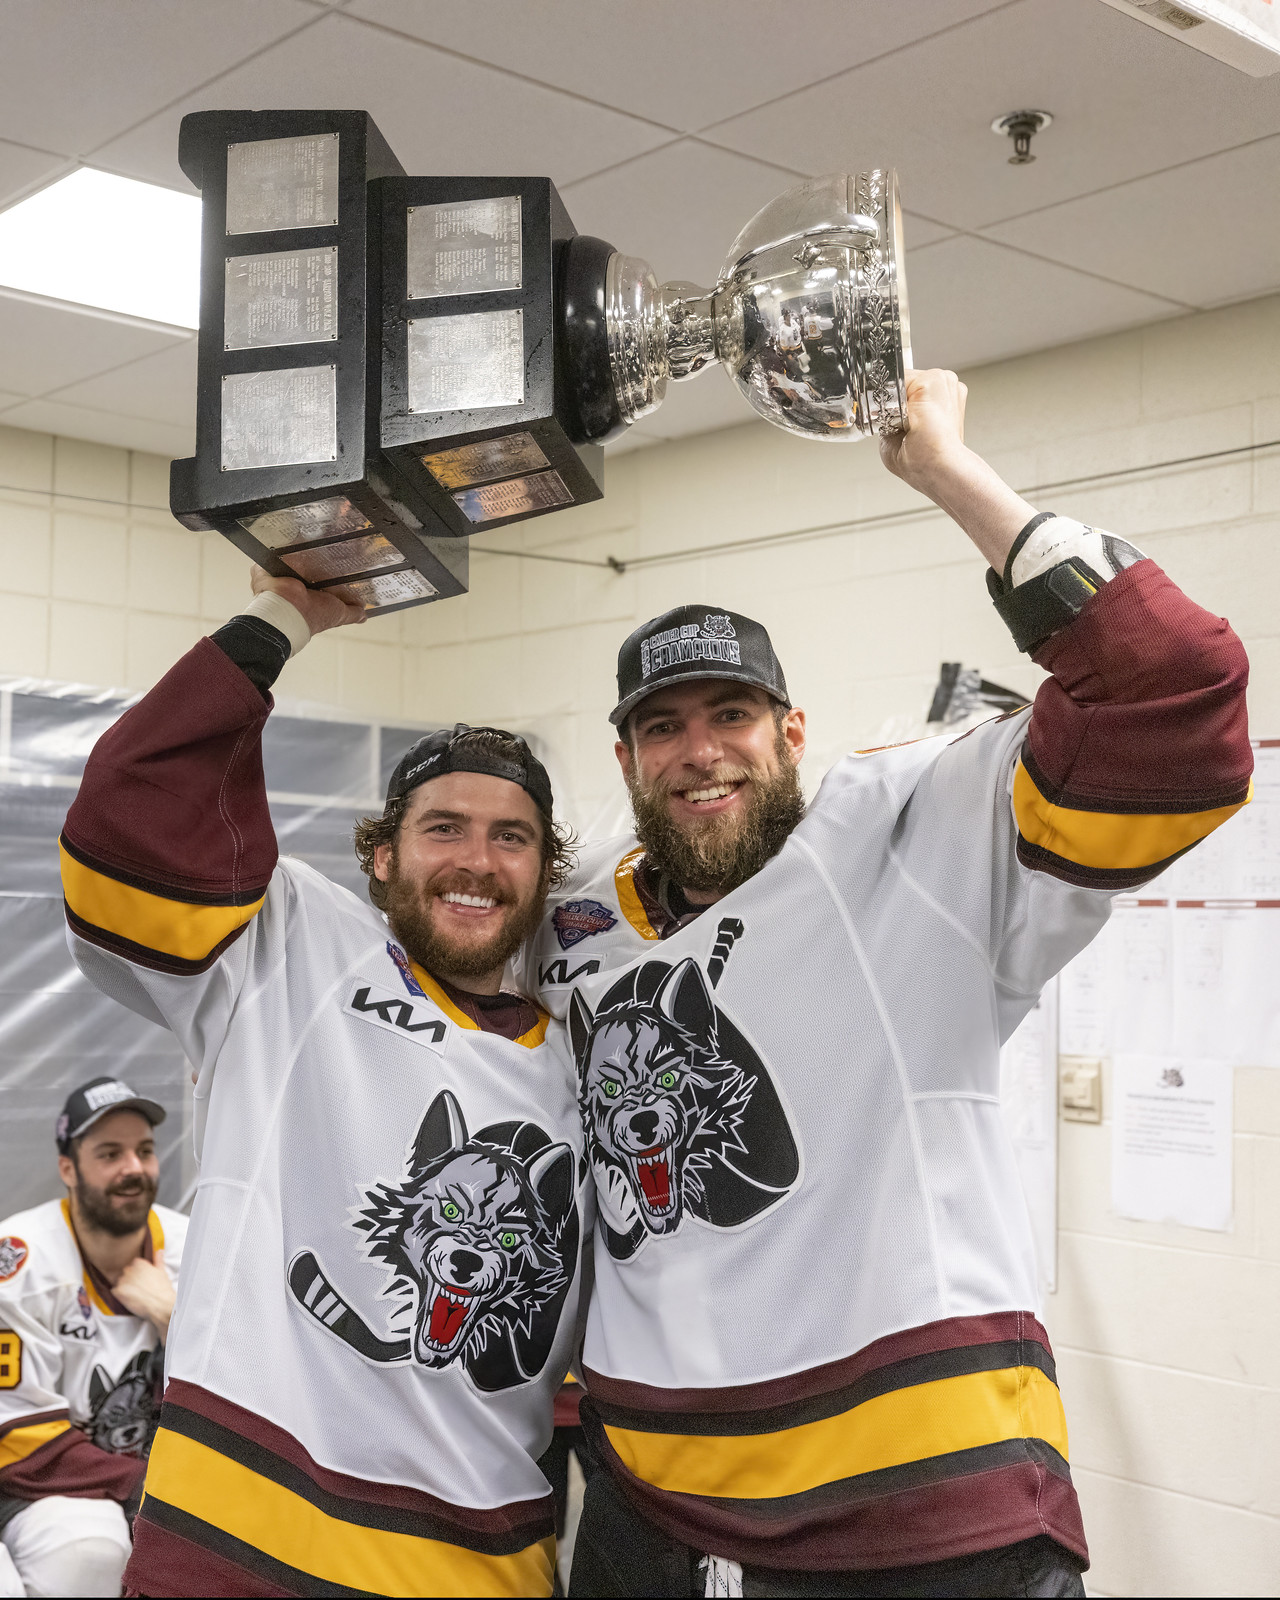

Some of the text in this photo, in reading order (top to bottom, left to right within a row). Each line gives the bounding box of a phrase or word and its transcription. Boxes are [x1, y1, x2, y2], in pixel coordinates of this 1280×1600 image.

[649, 624, 700, 649] CALDER CUP
[650, 638, 742, 672] CHAMPIONS
[405, 753, 441, 780] CCM
